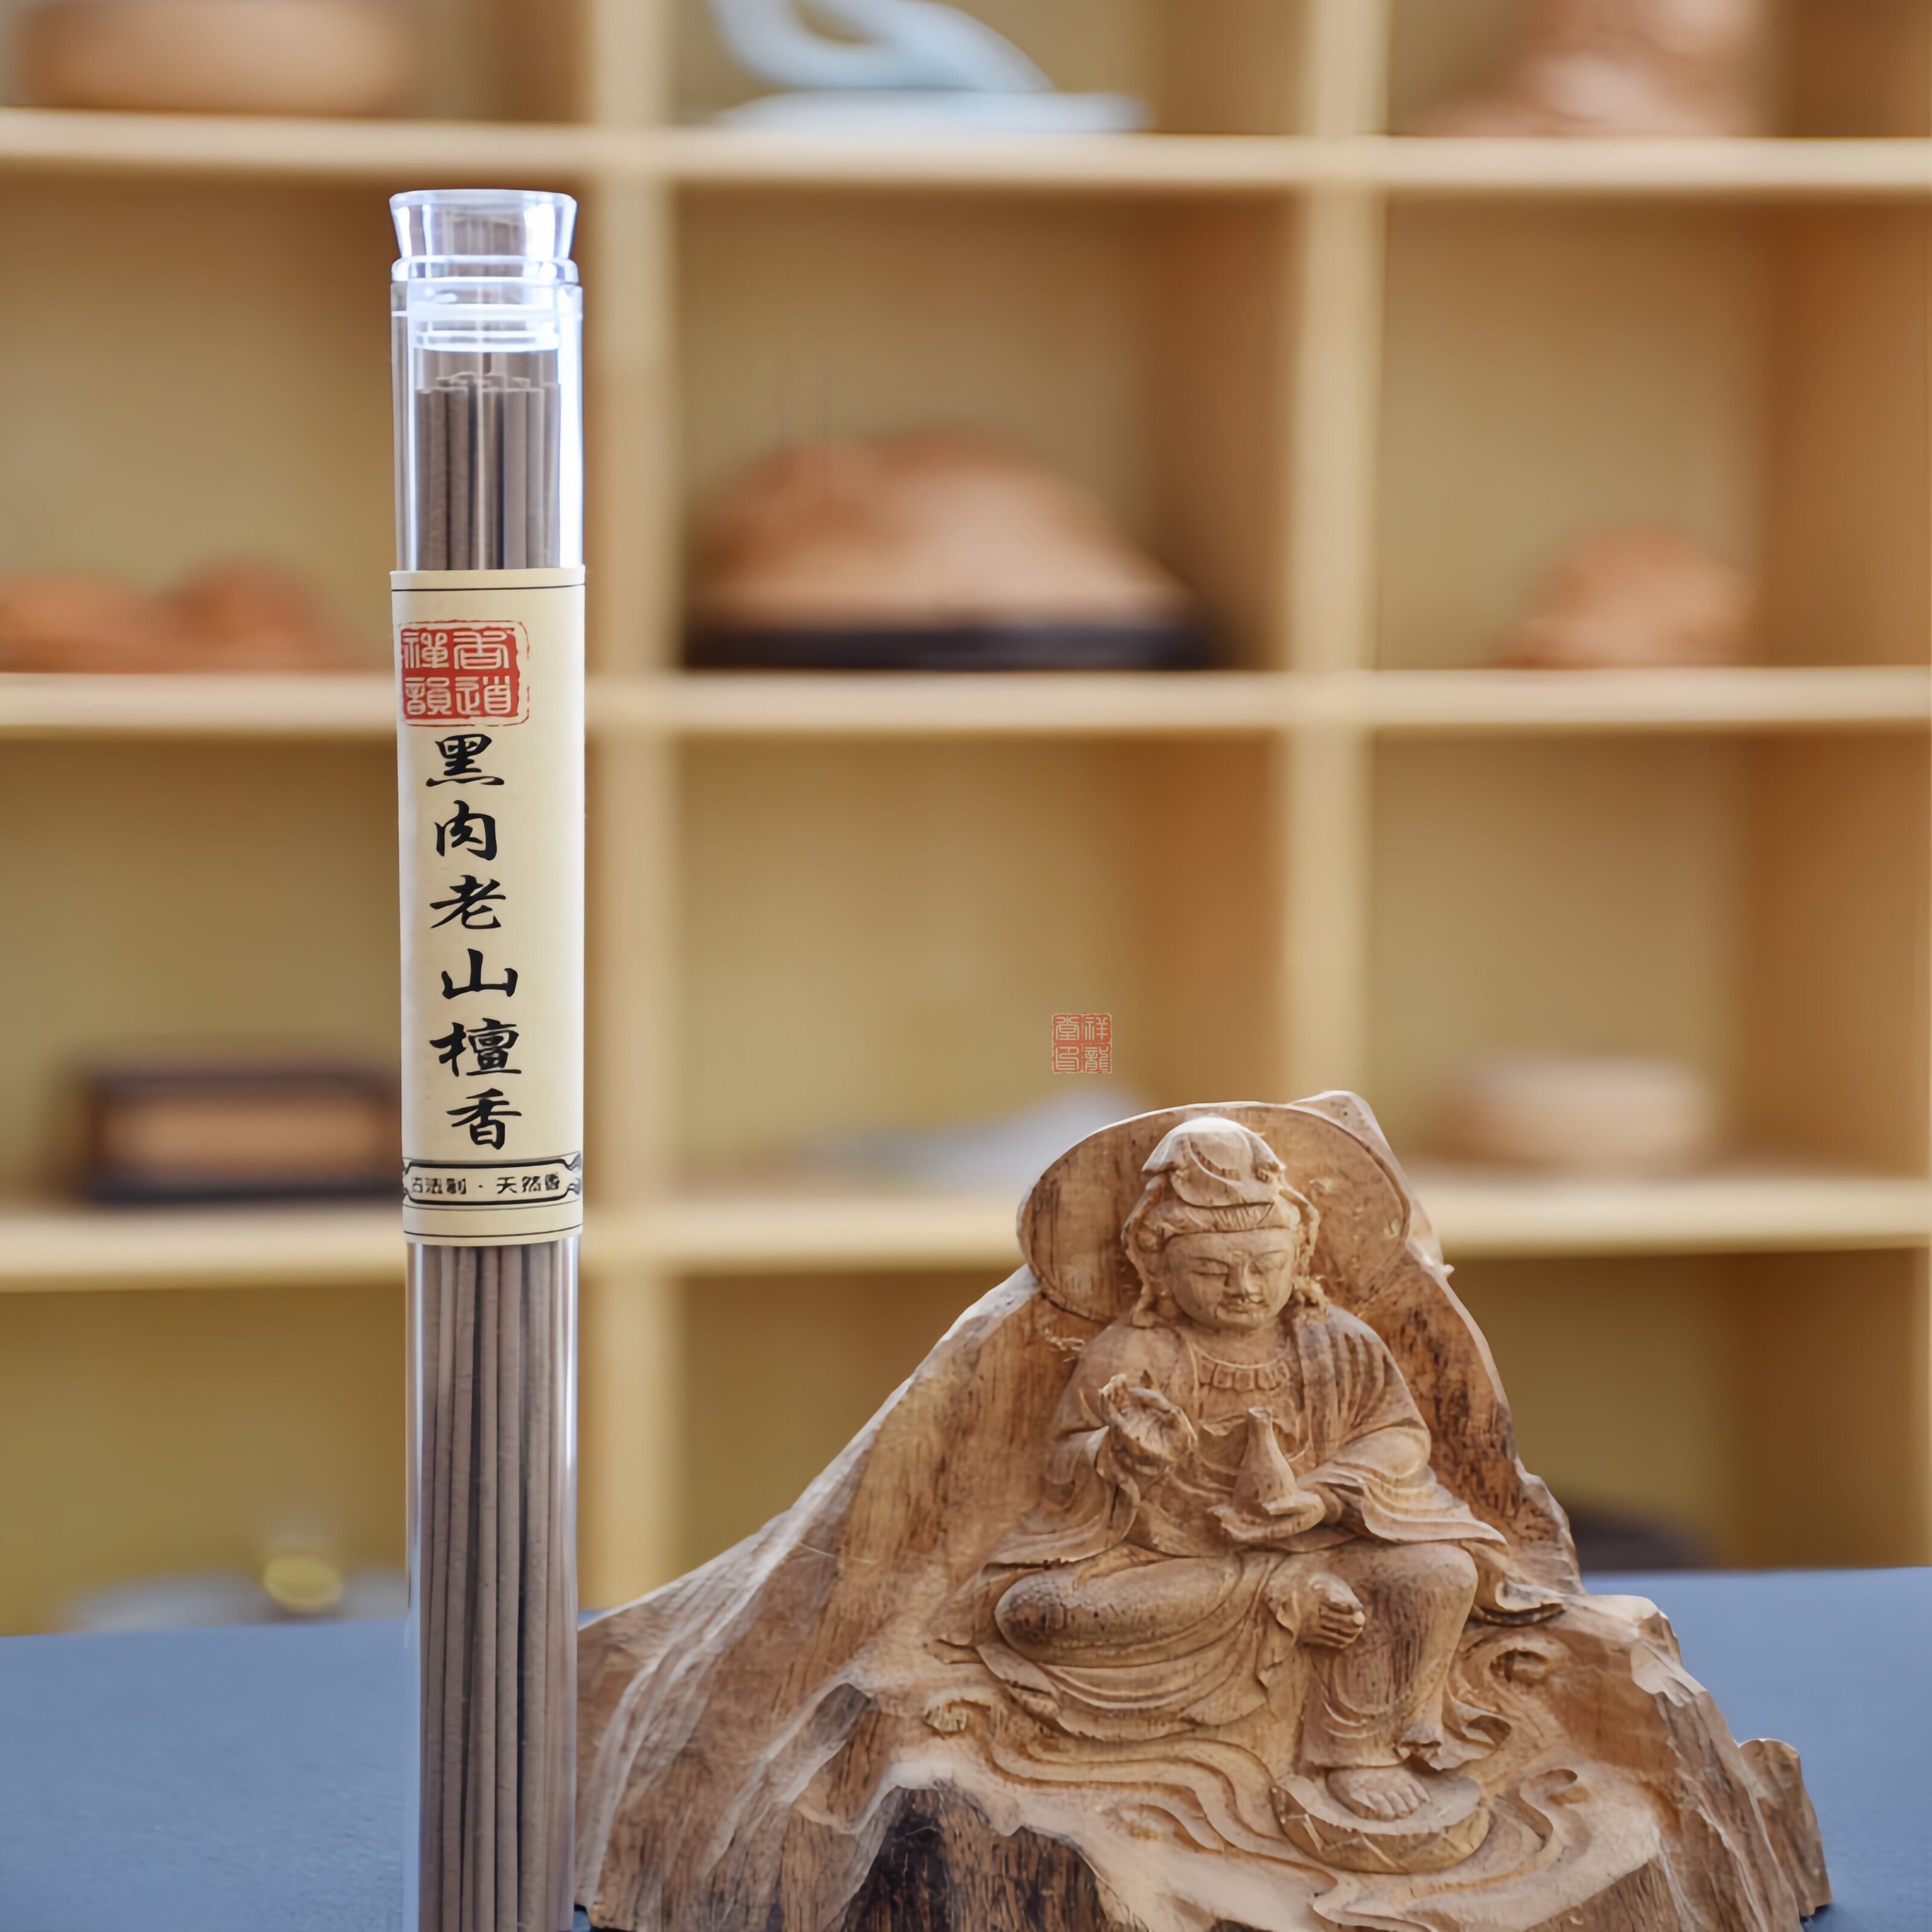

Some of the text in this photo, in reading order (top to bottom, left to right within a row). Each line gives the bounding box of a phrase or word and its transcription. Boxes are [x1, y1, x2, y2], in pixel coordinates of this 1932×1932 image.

[426, 733, 522, 1150] 黑肉老山檀香
